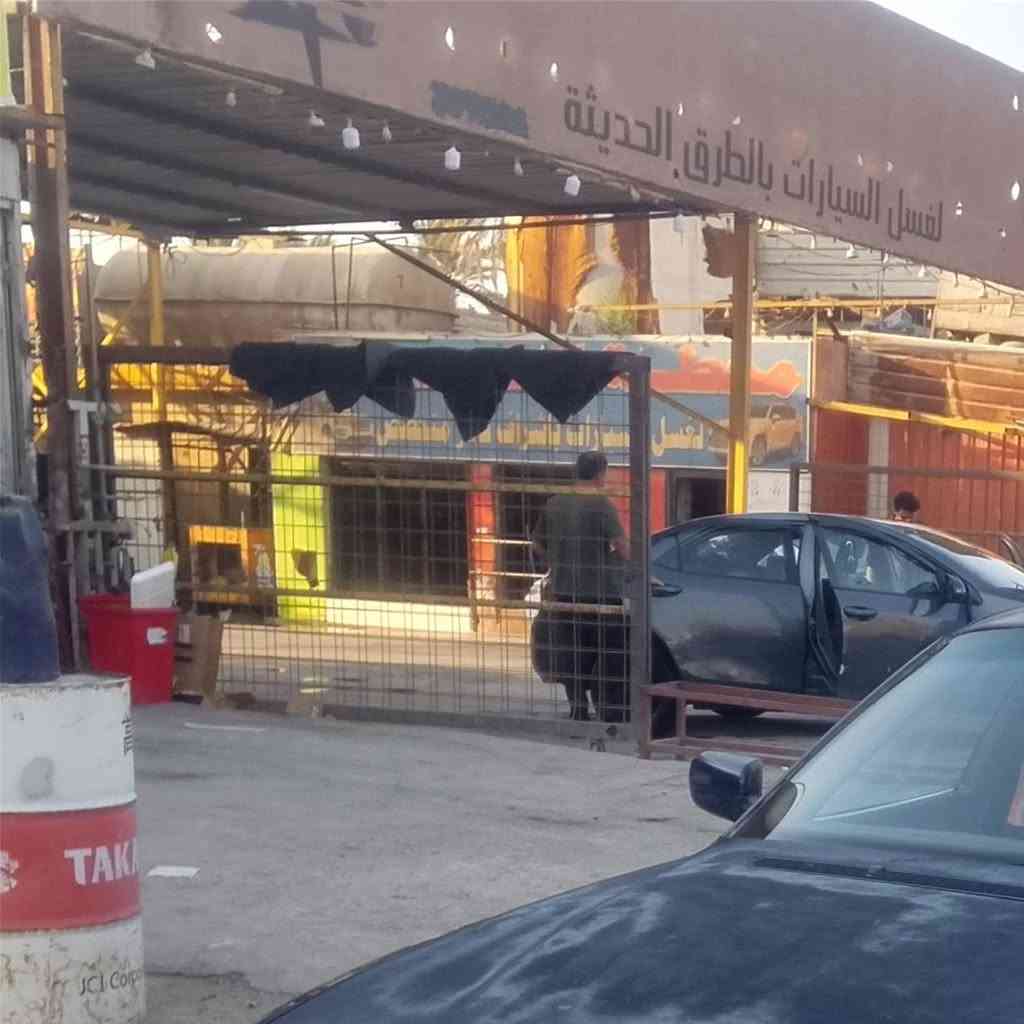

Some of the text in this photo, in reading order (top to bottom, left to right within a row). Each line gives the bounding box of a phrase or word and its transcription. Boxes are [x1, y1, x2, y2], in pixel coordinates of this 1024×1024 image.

[564, 85, 943, 242] لغسل السيارات بالطرق الحديثة
